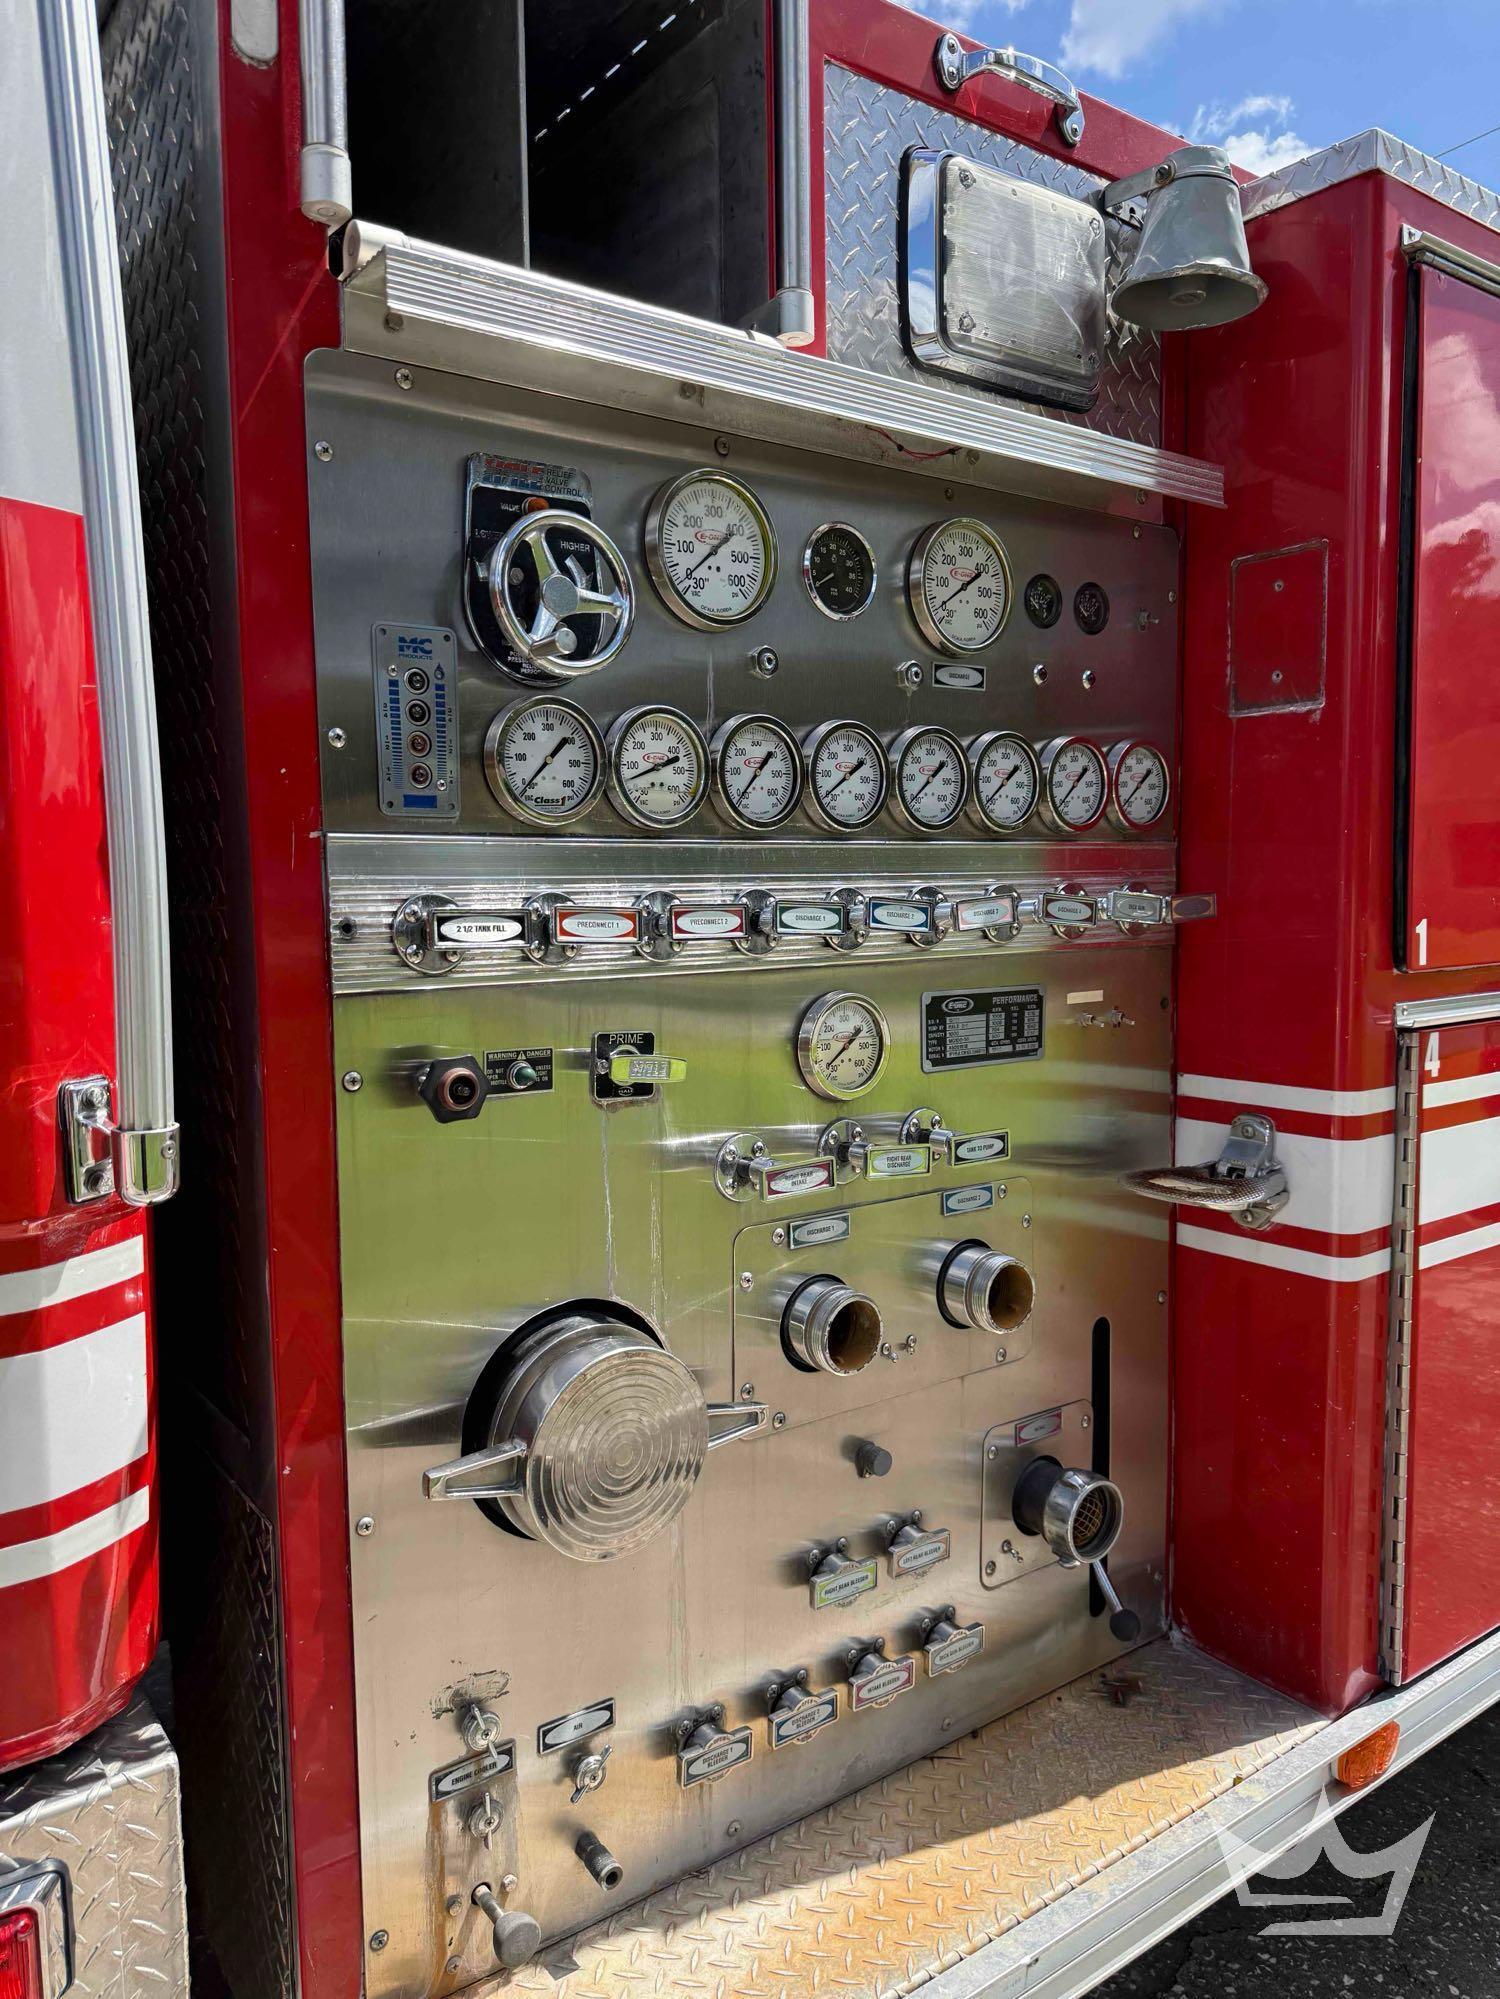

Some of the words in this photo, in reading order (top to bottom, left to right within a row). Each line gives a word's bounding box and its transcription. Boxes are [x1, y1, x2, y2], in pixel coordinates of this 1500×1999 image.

[547, 468, 575, 478] RELIEF
[546, 477, 568, 486] VALVE
[545, 485, 581, 497] CONTROL
[501, 502, 520, 512] VALVE
[704, 505, 723, 518] 300
[683, 515, 702, 528] 200
[560, 541, 591, 552] HIGHER
[677, 540, 695, 553] 100
[958, 545, 973, 558] 300
[731, 551, 749, 564] 500
[942, 554, 957, 566] 200
[975, 562, 990, 574] 400
[686, 568, 692, 580] 0
[728, 575, 745, 587] 600
[936, 575, 949, 588] 100
[977, 586, 992, 598] 500
[974, 608, 988, 619] 600
[399, 636, 432, 654] MC
[399, 653, 433, 661] PRODUCTS
[541, 723, 554, 732] 300
[523, 732, 536, 741] 200
[651, 732, 664, 741] 300
[632, 741, 646, 750] 200
[843, 744, 854, 752] 300
[668, 746, 681, 755] 400
[735, 748, 747, 757] 200
[925, 748, 936, 757] 300
[514, 753, 527, 762] 100
[827, 752, 839, 760] 200
[911, 756, 922, 765] 200
[1000, 752, 1011, 761] 300
[569, 760, 581, 768] 500
[626, 761, 639, 770] 100
[987, 759, 998, 768] 200
[673, 766, 685, 775] 500
[730, 767, 741, 776] 100
[771, 770, 783, 778] 500
[821, 770, 832, 778] 100
[521, 778, 526, 786] 0
[860, 776, 871, 784] 500
[905, 773, 916, 782] 100
[942, 777, 952, 786] 500
[981, 775, 992, 784] 100
[562, 780, 575, 788] 600
[1015, 781, 1025, 789] 500
[1054, 781, 1063, 789] 100
[1085, 780, 1094, 788] 500
[1148, 782, 1157, 791] 500
[736, 788, 741, 797] 0
[767, 788, 779, 797] 600
[855, 793, 865, 801] 600
[937, 794, 948, 803] 600
[1010, 797, 1021, 805] 600
[795, 914, 822, 922] DISCHARGE
[886, 911, 910, 919] DISCHARGE
[577, 921, 614, 929] PRECONNECT
[690, 918, 724, 926] PRECONNECT
[463, 925, 474, 933] 1/2
[475, 925, 492, 933] TANK
[492, 924, 507, 933] FILL
[1415, 918, 1428, 965] 1
[992, 994, 1039, 1005] PERFORMANCE
[839, 1015, 849, 1023] 300
[824, 1025, 834, 1033] 200
[609, 1033, 644, 1045] PRIME
[820, 1043, 831, 1051] 100
[859, 1042, 870, 1050] 500
[488, 1052, 517, 1060] WARNING
[1423, 1032, 1440, 1077] 4
[854, 1059, 865, 1067] 600
[983, 1143, 995, 1151] PUMP
[886, 1161, 911, 1169] DISCHARGE
[785, 1172, 799, 1180] RIGHT
[800, 1170, 814, 1178] REAR
[791, 1178, 807, 1187] INTAKE
[958, 1196, 978, 1204] DISCHARGE
[807, 1226, 831, 1236] DISCHARGE
[902, 1556, 913, 1565] LEFT
[913, 1551, 924, 1561] REAR
[924, 1545, 941, 1556] BLEEDER
[824, 1586, 838, 1596] RIGHT
[838, 1581, 850, 1592] REAR
[850, 1574, 869, 1587] BLEEDER
[958, 1640, 975, 1653] BLEEDER
[867, 1683, 882, 1694] INTAKE
[882, 1676, 900, 1689] BLEEDER
[791, 1711, 816, 1726] DISCHARGE
[796, 1717, 816, 1729] BLEEDER
[573, 1722, 583, 1731] AIR
[702, 1749, 729, 1765] DISCHARGE
[707, 1755, 729, 1769] BLEEDER
[451, 1769, 473, 1786] ENGINE
[474, 1761, 497, 1777] COOLER
